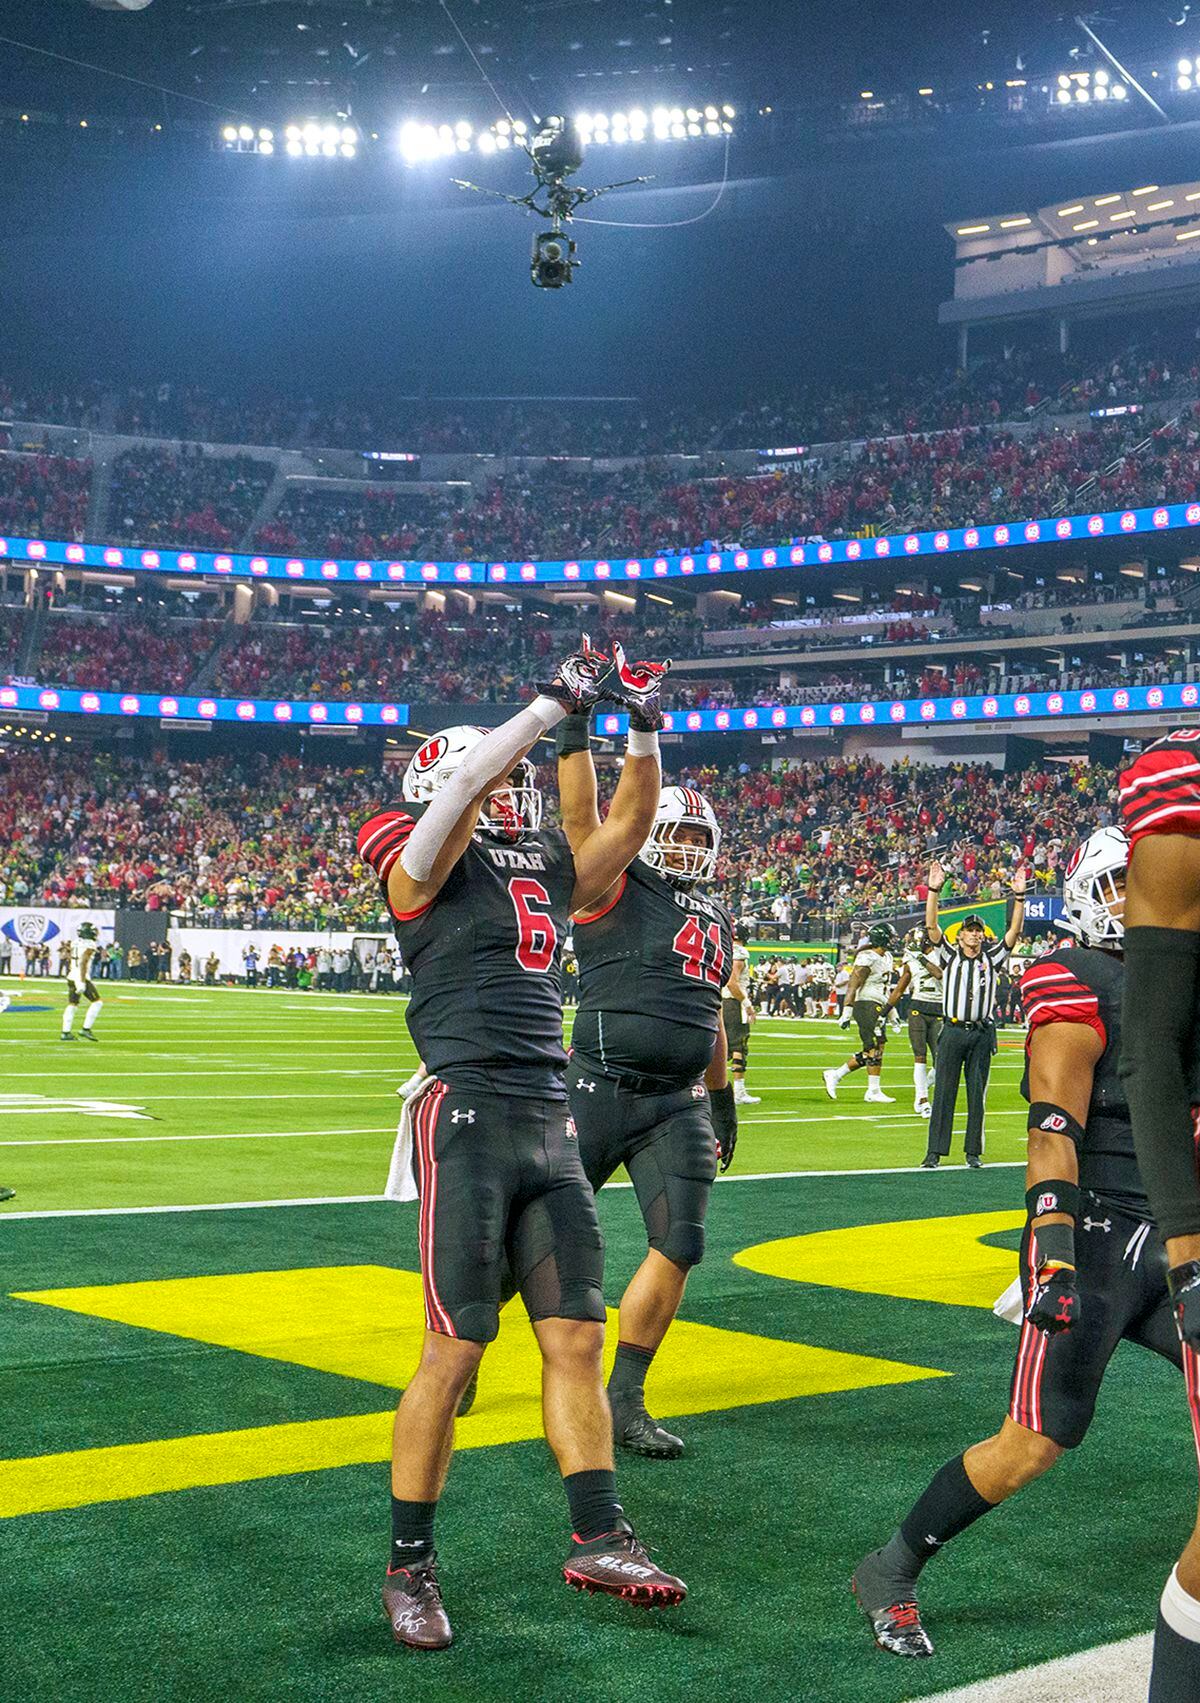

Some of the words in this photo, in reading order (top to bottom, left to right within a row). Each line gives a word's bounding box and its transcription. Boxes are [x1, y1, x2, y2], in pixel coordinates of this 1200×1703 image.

[418, 739, 440, 767] U
[488, 849, 546, 871] UTAH
[674, 891, 714, 916] UTAH
[508, 876, 557, 973] 6
[672, 914, 724, 987] 41
